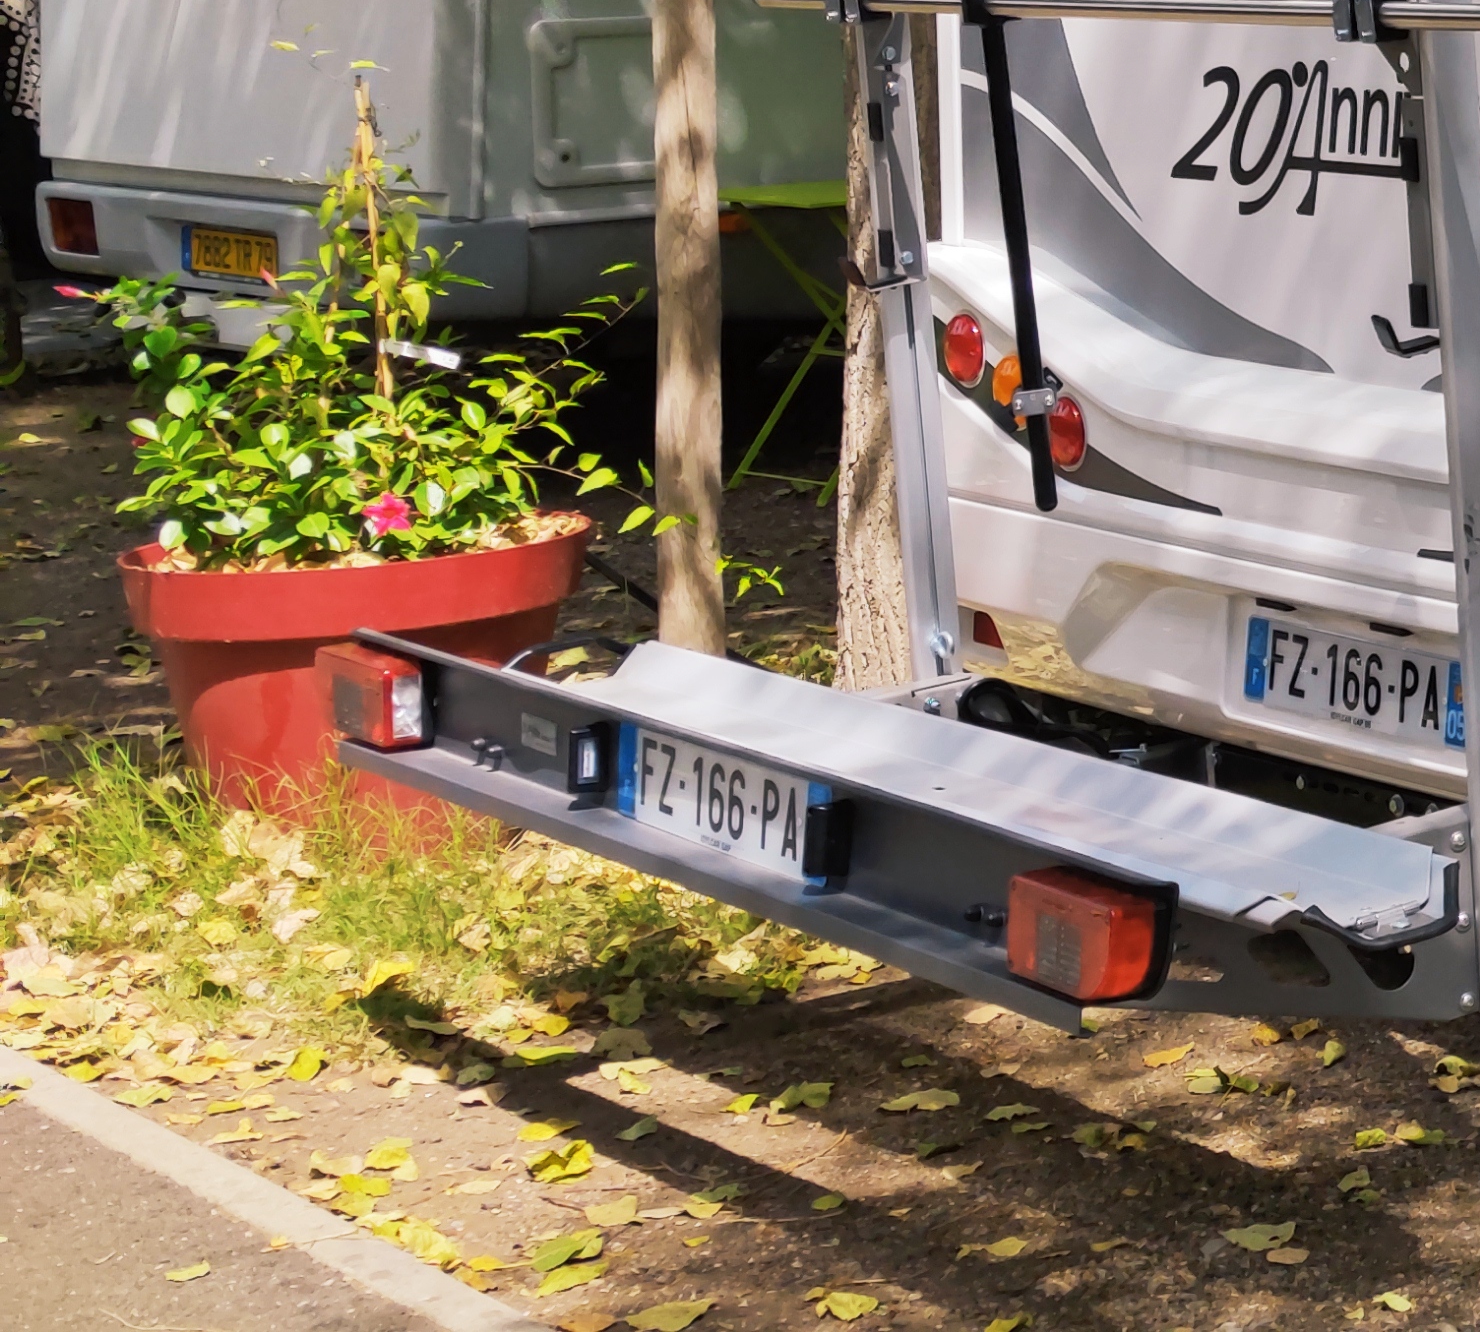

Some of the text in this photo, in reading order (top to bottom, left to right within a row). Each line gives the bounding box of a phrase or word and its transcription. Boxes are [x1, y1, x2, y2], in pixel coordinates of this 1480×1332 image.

[195, 233, 275, 274] 7882 TR 79
[1268, 629, 1440, 732] FZ-166-PA
[1447, 709, 1465, 741] 05
[639, 736, 798, 862] FZ-166-PA
